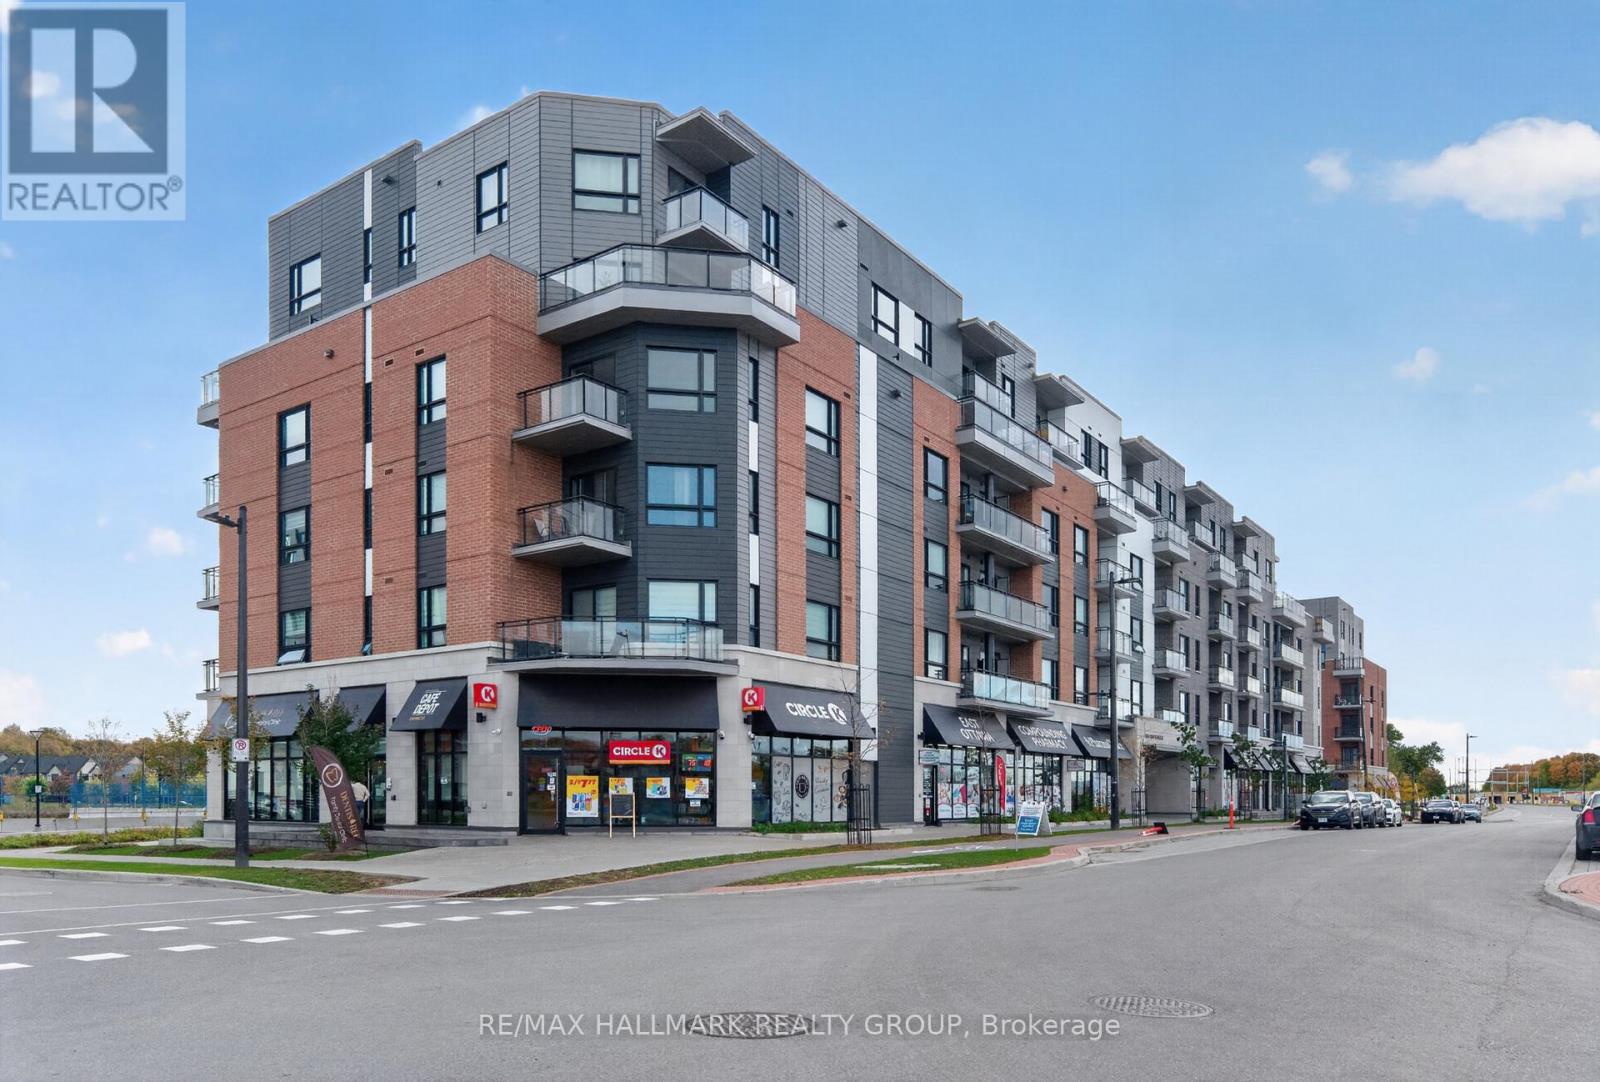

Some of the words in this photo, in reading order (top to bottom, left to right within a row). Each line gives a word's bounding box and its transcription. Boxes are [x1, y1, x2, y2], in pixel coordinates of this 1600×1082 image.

[785, 702, 830, 719] CIRCLE
[828, 703, 847, 724] K
[958, 717, 980, 728] EAST
[612, 746, 650, 756] CIRCLE
[653, 745, 666, 757] K
